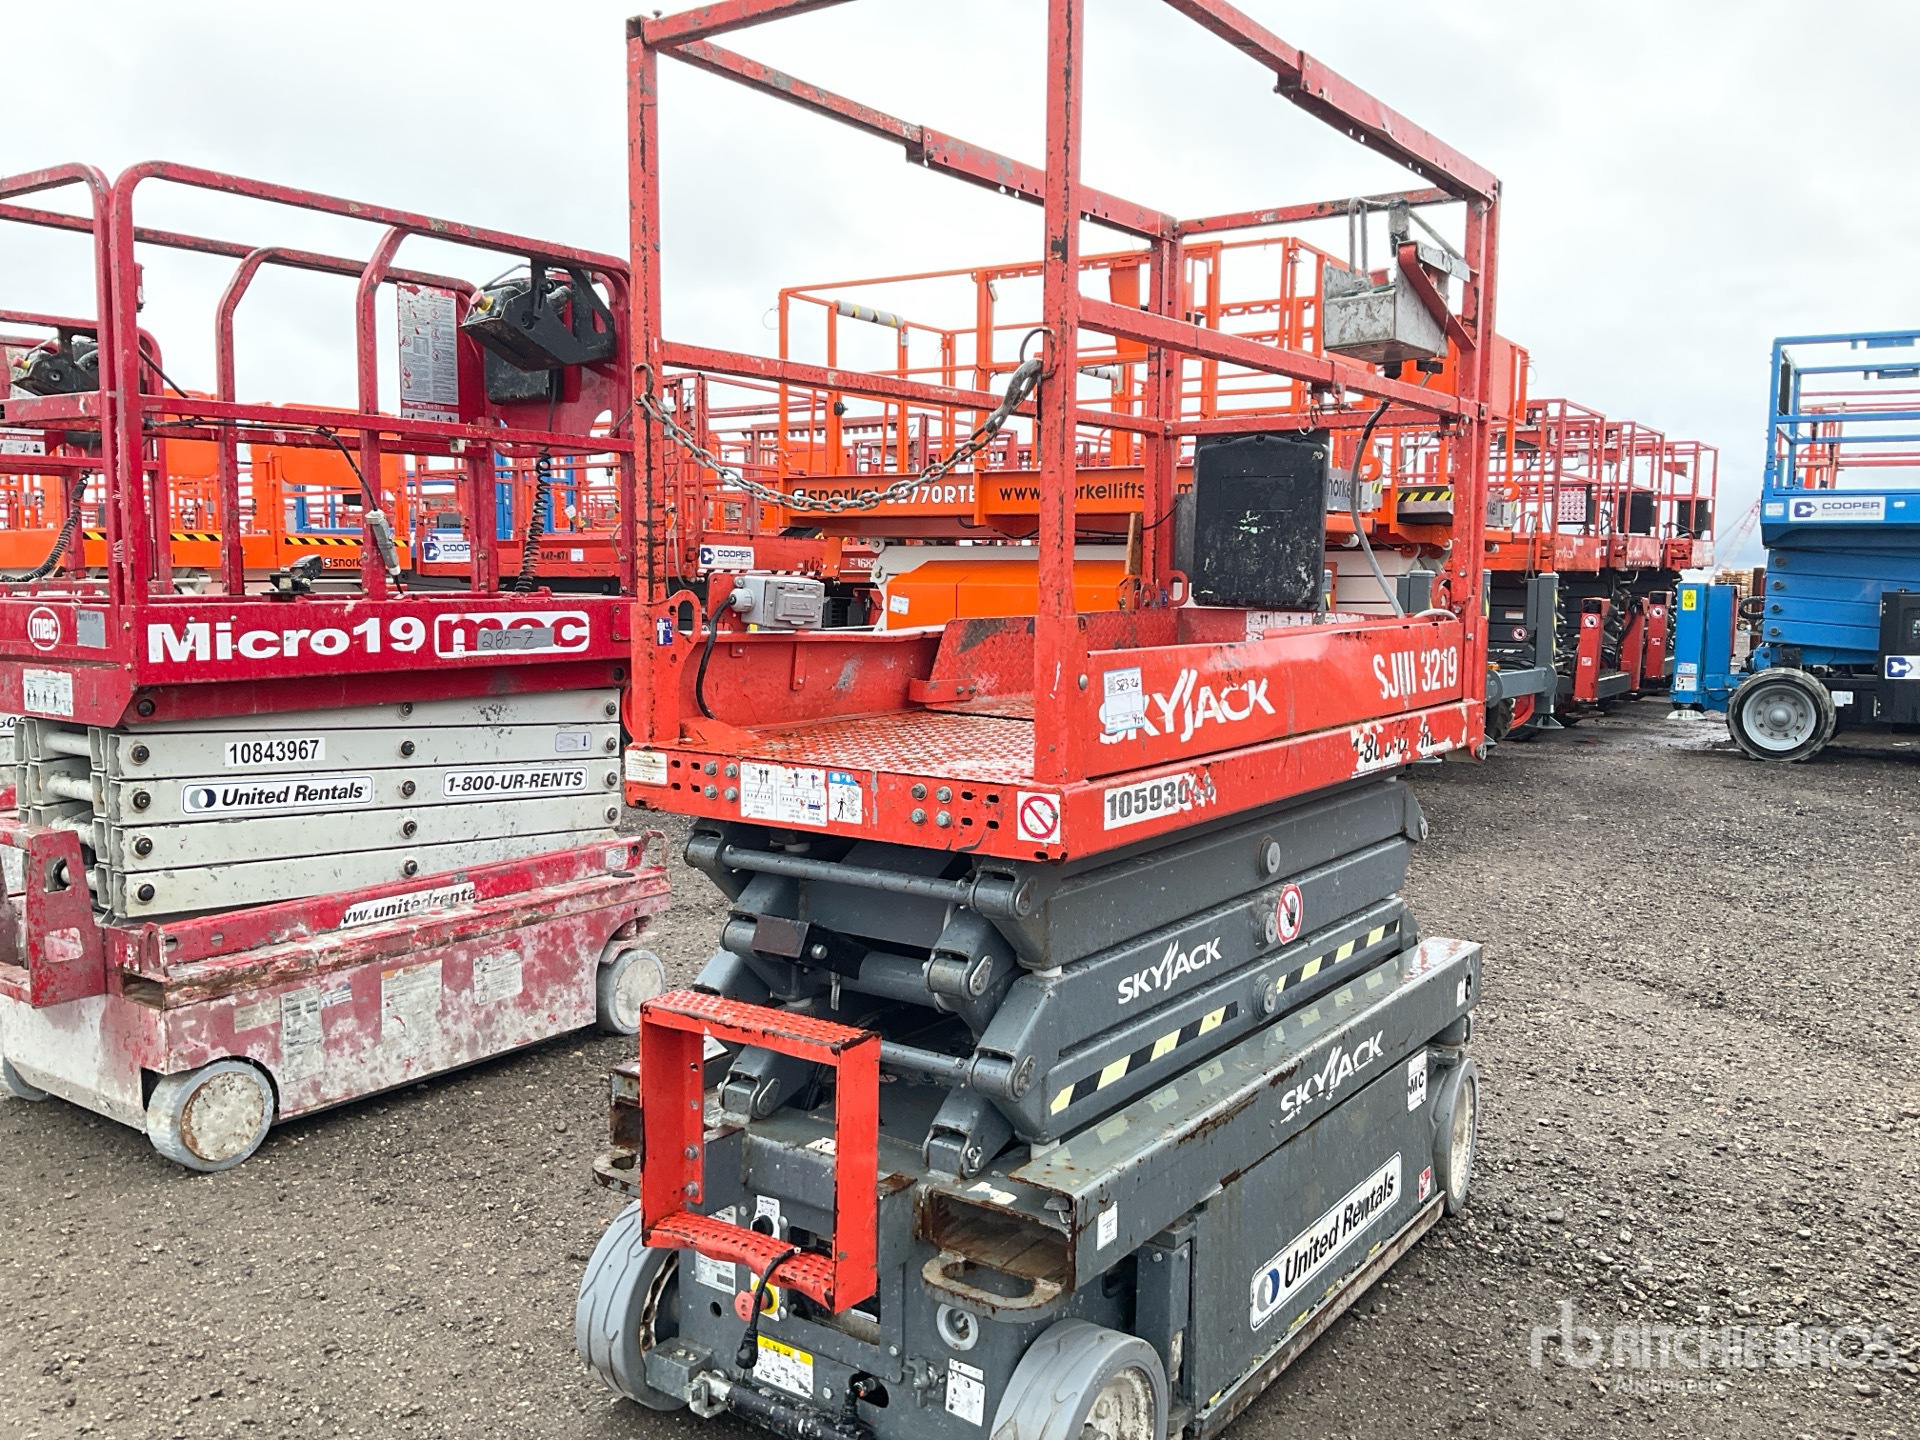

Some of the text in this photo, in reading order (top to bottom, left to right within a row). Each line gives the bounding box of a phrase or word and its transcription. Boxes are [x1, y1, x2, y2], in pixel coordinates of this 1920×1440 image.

[1822, 502, 1880, 510] COOPER
[148, 616, 425, 662] Micro19
[1421, 646, 1458, 692] 3219
[228, 739, 320, 765] 10843967
[222, 783, 364, 806] United Rentals
[447, 771, 583, 792] 1-800-UR-RENTS
[1118, 937, 1222, 1004] SKYJACK
[1280, 1030, 1383, 1124] SKYJACK
[1284, 1172, 1395, 1288] United Rentals
